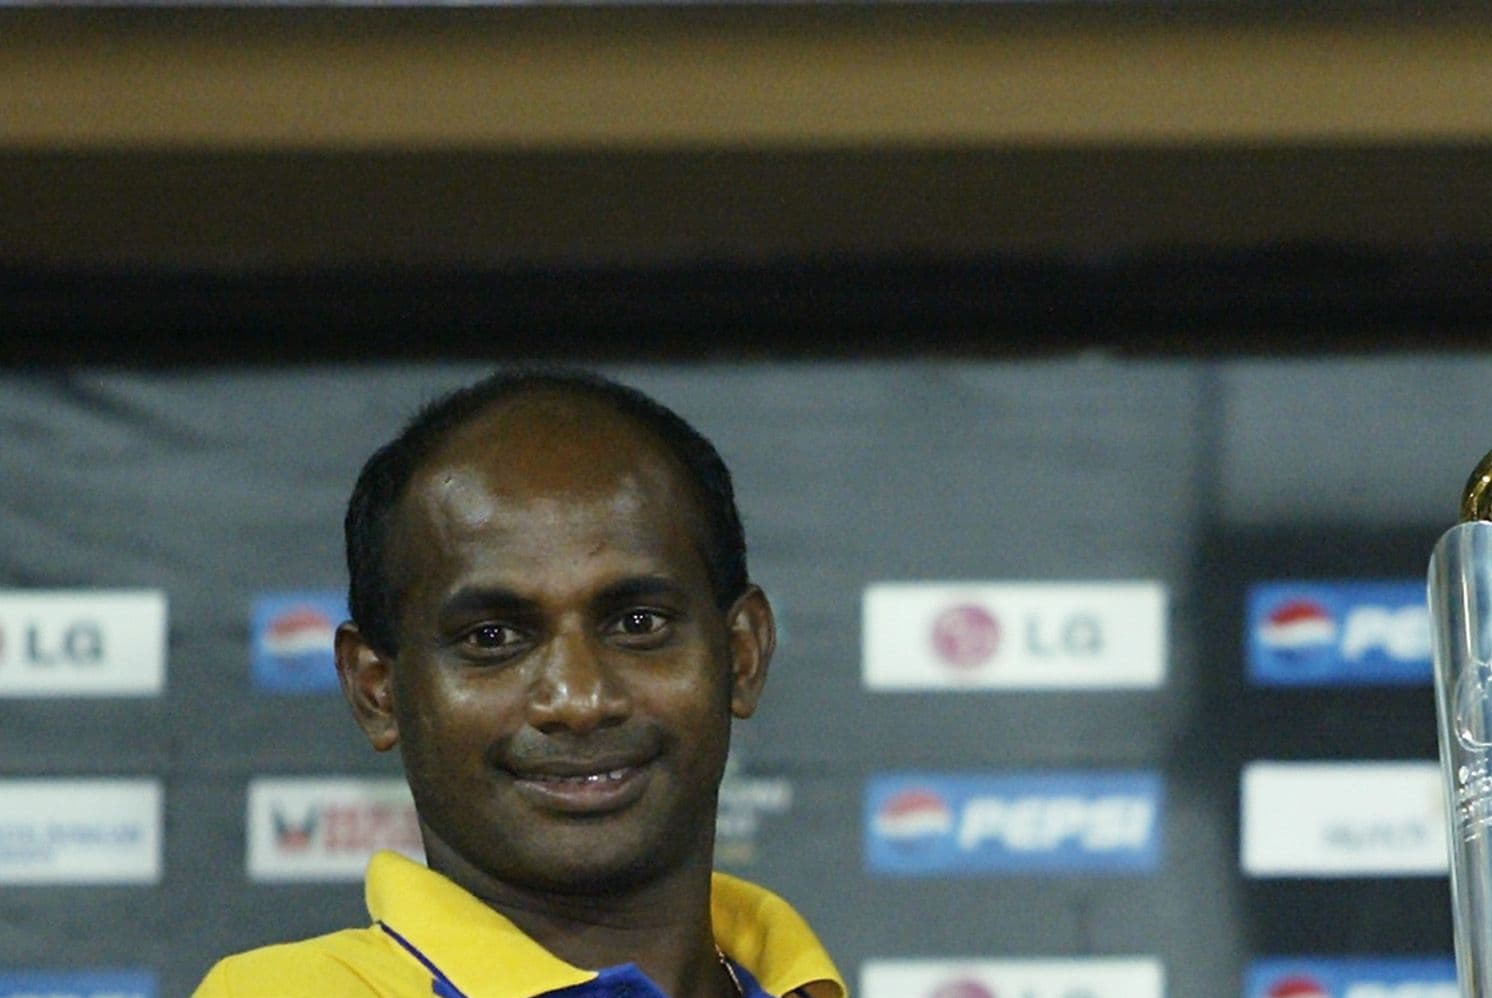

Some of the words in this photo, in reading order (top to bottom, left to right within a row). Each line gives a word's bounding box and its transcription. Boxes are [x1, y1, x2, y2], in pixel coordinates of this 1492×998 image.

[24, 619, 106, 667] LG
[1022, 611, 1103, 659] LG
[957, 797, 1157, 852] PEPSI
